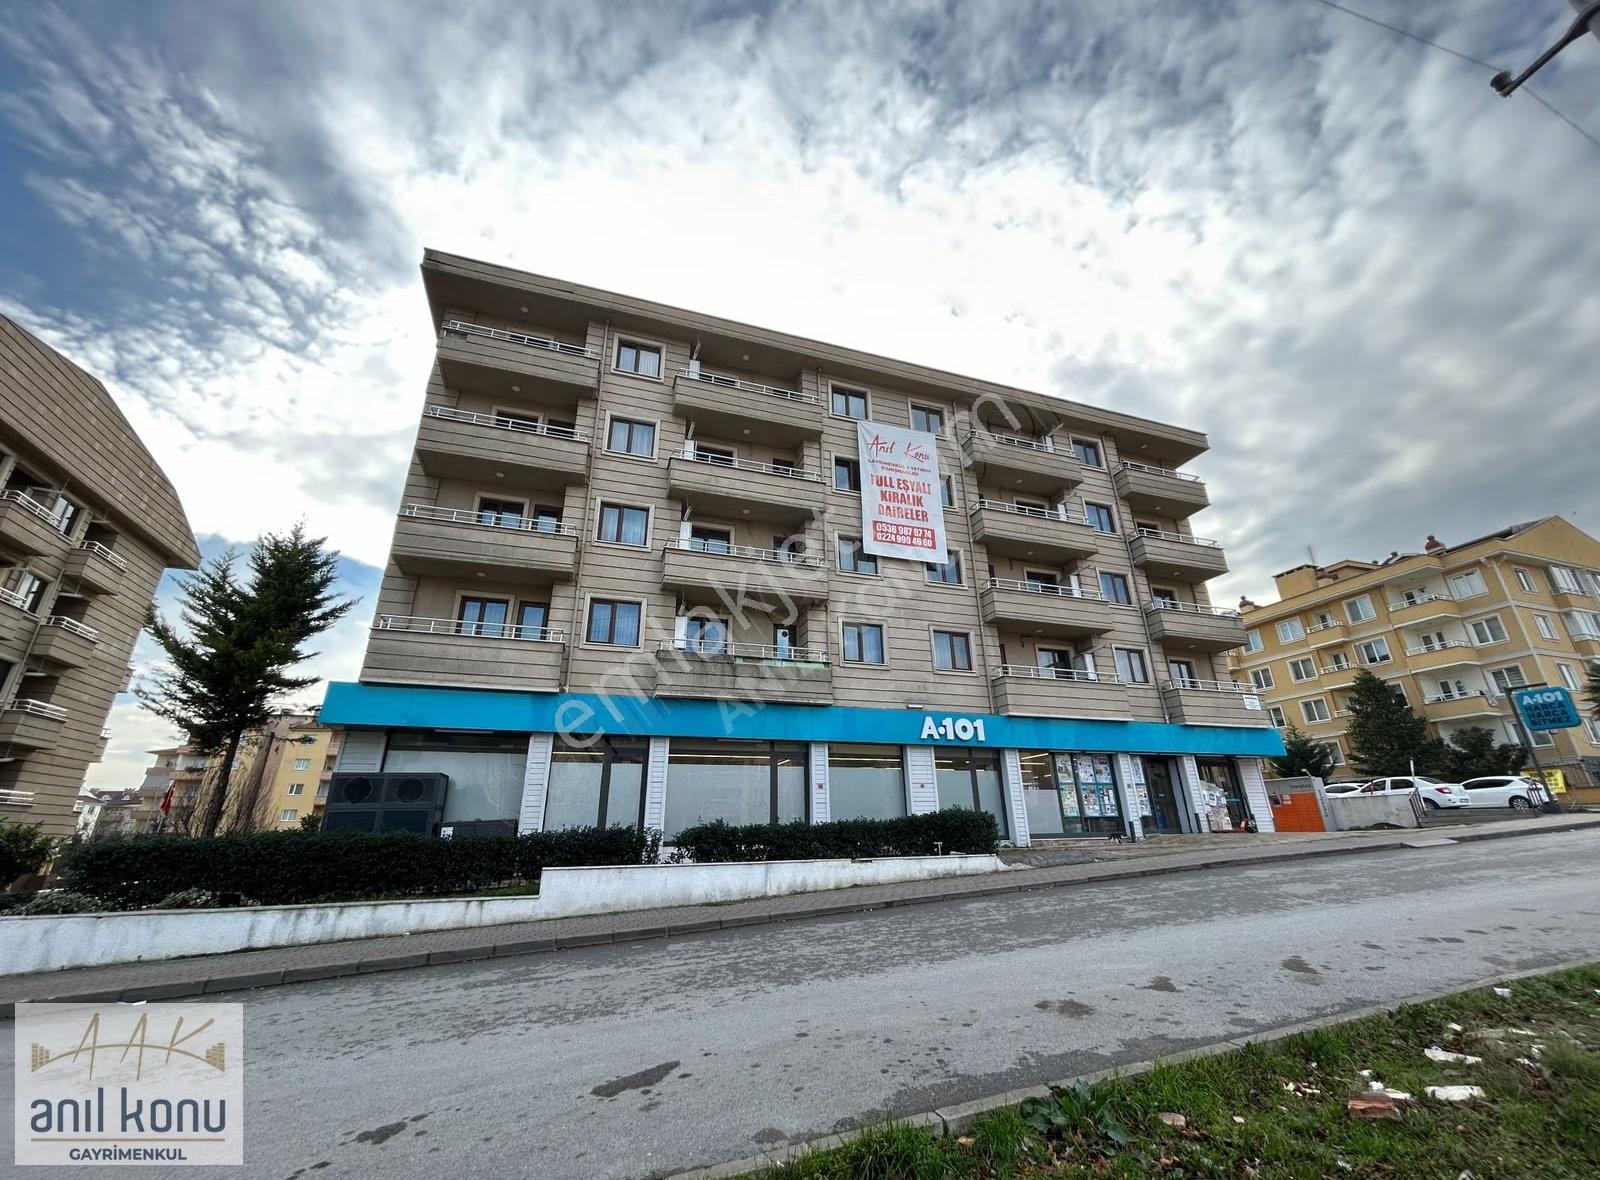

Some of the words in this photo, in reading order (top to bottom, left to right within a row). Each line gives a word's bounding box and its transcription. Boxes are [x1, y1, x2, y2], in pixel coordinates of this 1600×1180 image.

[904, 442, 930, 463] Konu
[871, 473, 895, 488] FULL
[897, 478, 932, 495] EŞYALI
